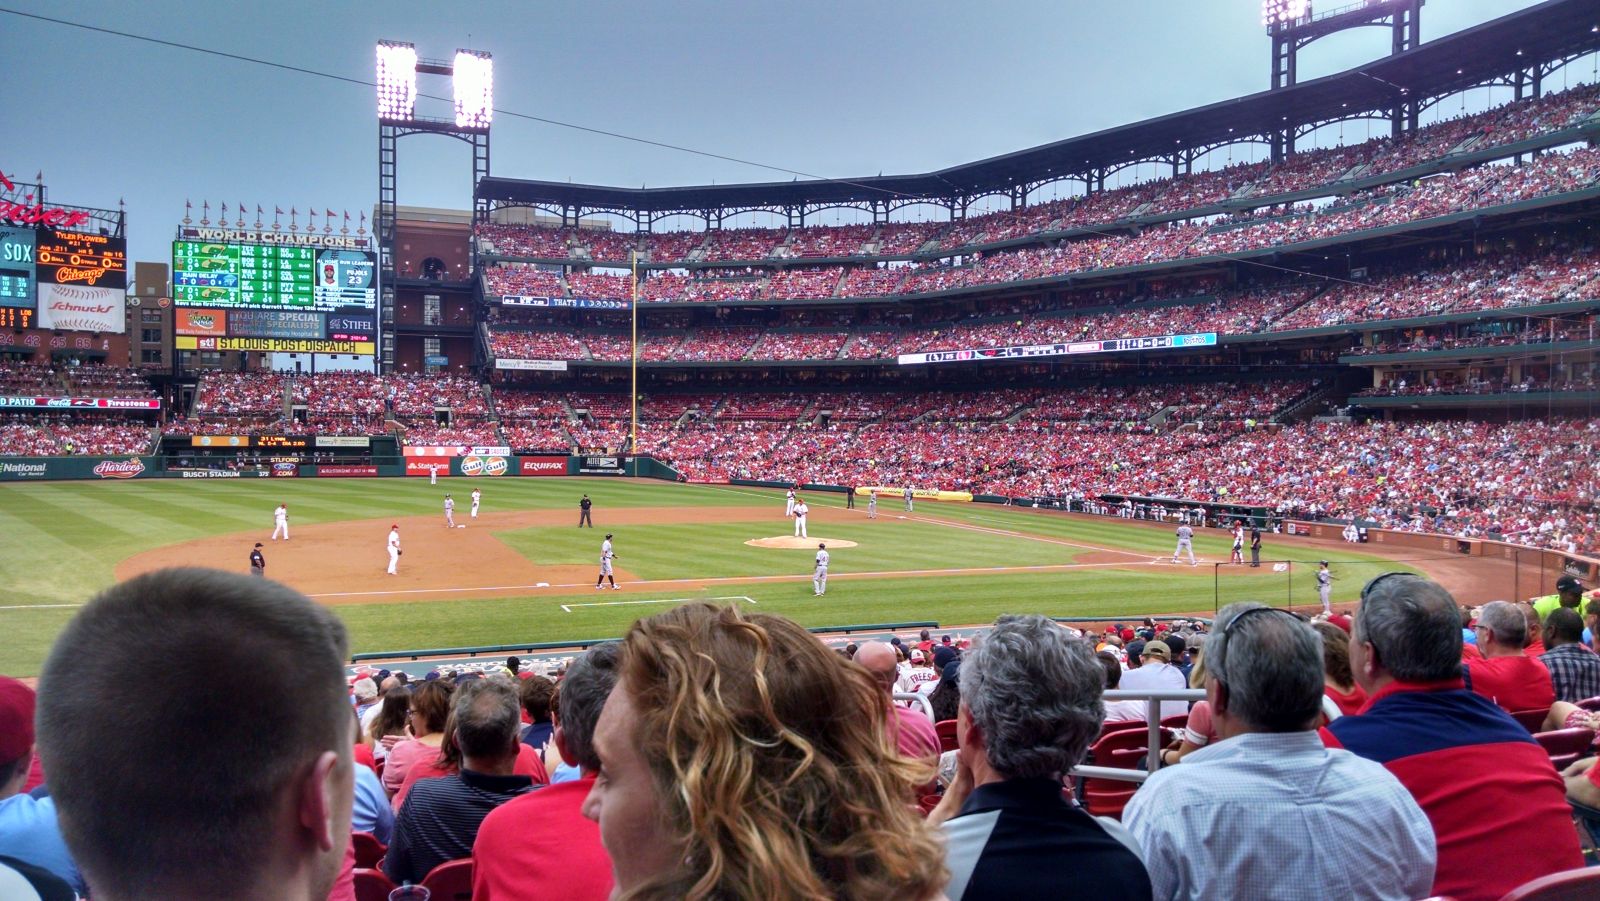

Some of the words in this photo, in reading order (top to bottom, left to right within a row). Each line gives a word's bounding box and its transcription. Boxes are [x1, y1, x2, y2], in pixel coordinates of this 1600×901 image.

[56, 231, 76, 240] TYLER
[77, 234, 108, 244] FLOWERS
[197, 228, 257, 241] WORLD
[262, 232, 356, 247] CHAMPIONS
[4, 243, 32, 262] SOX
[57, 267, 105, 285] Chicago
[348, 276, 362, 284] 23
[48, 302, 114, 313] Schnucks
[554, 298, 577, 307] THAT'S
[580, 299, 585, 307] A
[257, 312, 275, 321] ARE
[278, 312, 319, 322] SPECIAL
[267, 321, 319, 329] SPECIALISTS
[342, 320, 373, 330] STIFEL
[200, 338, 215, 347] stl
[220, 338, 236, 349] ST.
[238, 339, 269, 349] LOUIS
[274, 340, 356, 352] POST-DISPATCH
[9, 398, 36, 406] PATIO
[106, 400, 150, 408] Firestone
[3, 463, 46, 472] National
[462, 460, 482, 471] Gulf
[486, 461, 505, 471] Gulf
[524, 462, 563, 471] EQUIFAX
